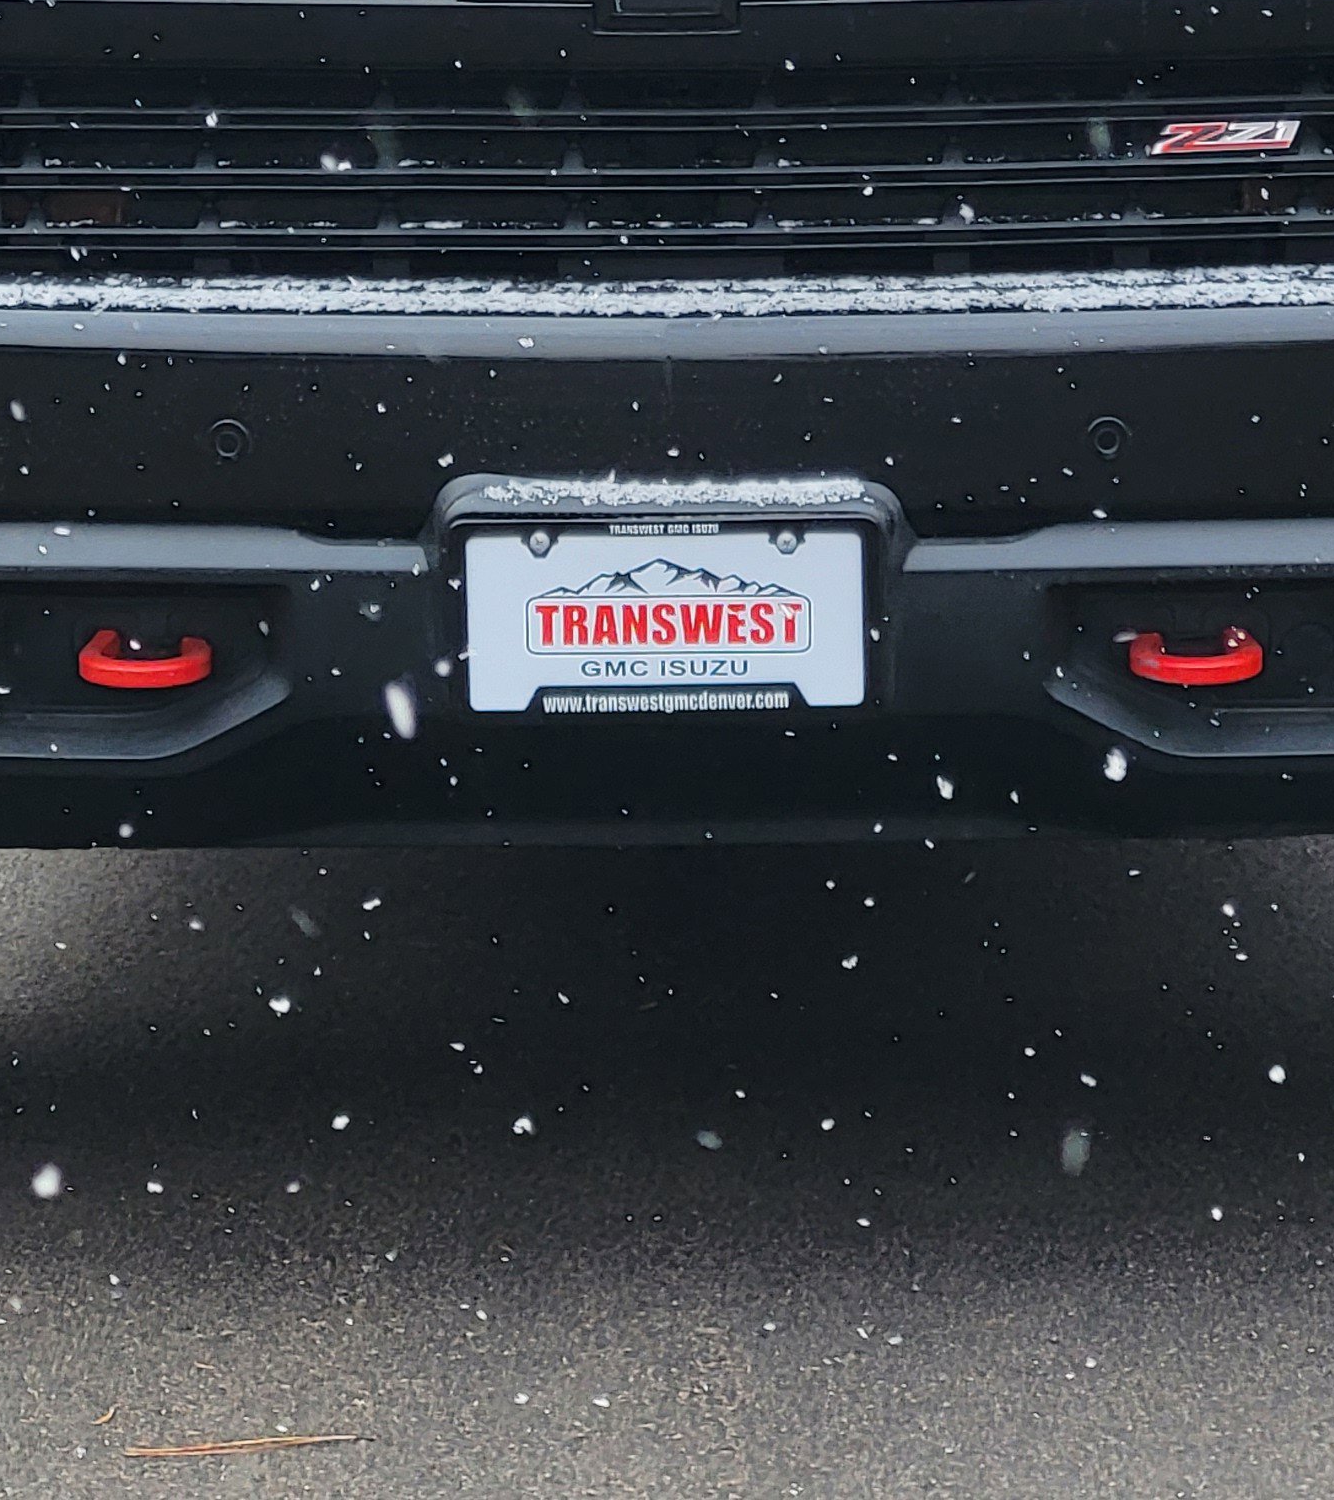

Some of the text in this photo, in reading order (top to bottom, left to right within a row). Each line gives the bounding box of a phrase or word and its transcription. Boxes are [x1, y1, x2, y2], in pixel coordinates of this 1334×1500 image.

[1152, 121, 1301, 155] Z71
[609, 523, 719, 535] TRANSWEST GMC ISUZU
[535, 603, 802, 645] TRANSWEST
[581, 660, 749, 677] GMC ISUZU
[543, 691, 789, 714] www.transwestgmcdenver.com
